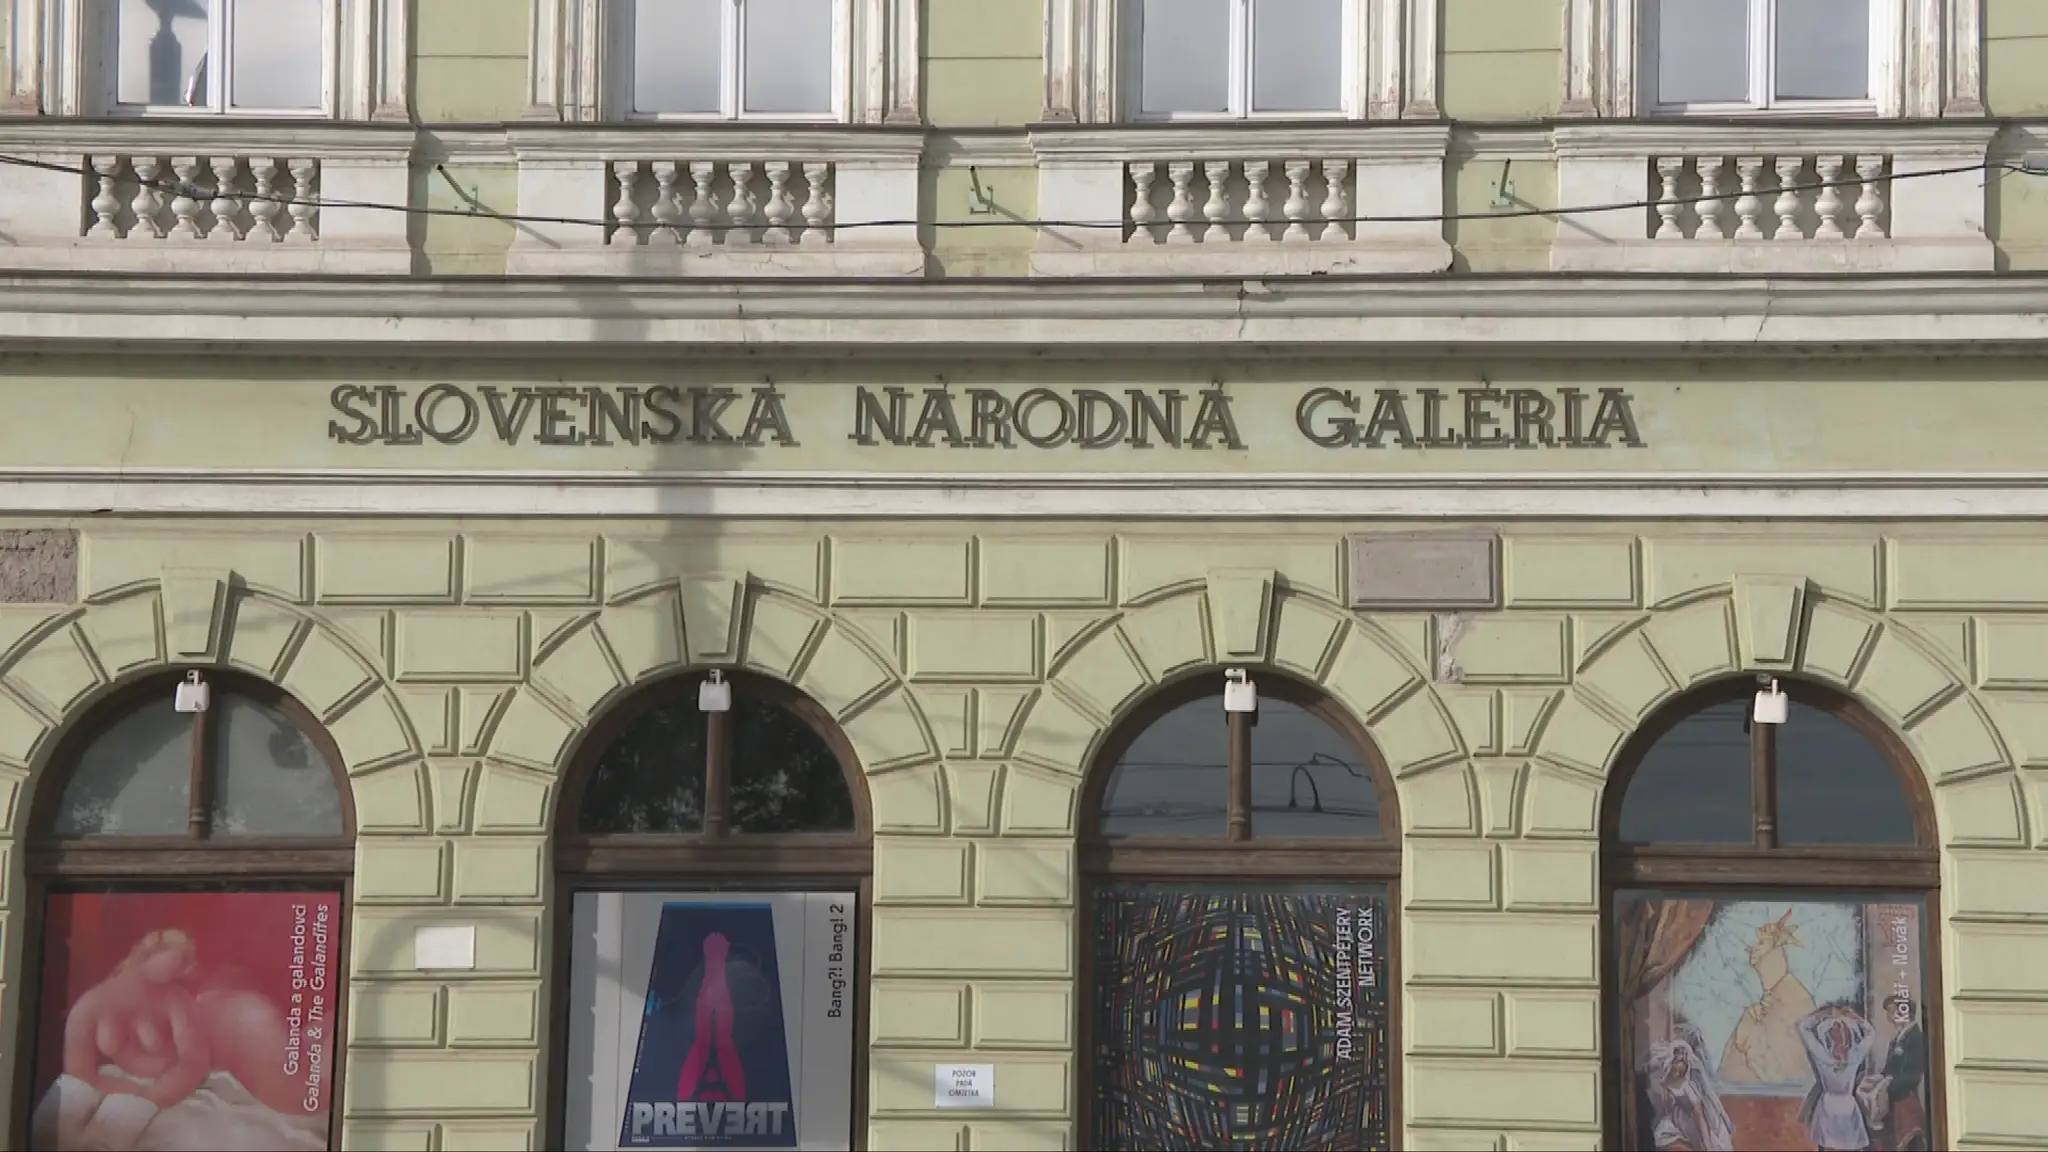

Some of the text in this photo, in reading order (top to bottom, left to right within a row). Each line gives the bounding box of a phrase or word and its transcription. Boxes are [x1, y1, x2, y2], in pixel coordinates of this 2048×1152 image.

[827, 904, 847, 1018] Bang?! Bang! 2
[1358, 907, 1374, 986] NETWORK
[1892, 917, 1908, 965] Novák
[284, 904, 307, 1076] Galanda a galandovci
[307, 996, 324, 1022] The
[306, 1028, 322, 1039] &
[1336, 1013, 1351, 1061] ADAM
[304, 1043, 322, 1112] Galanda
